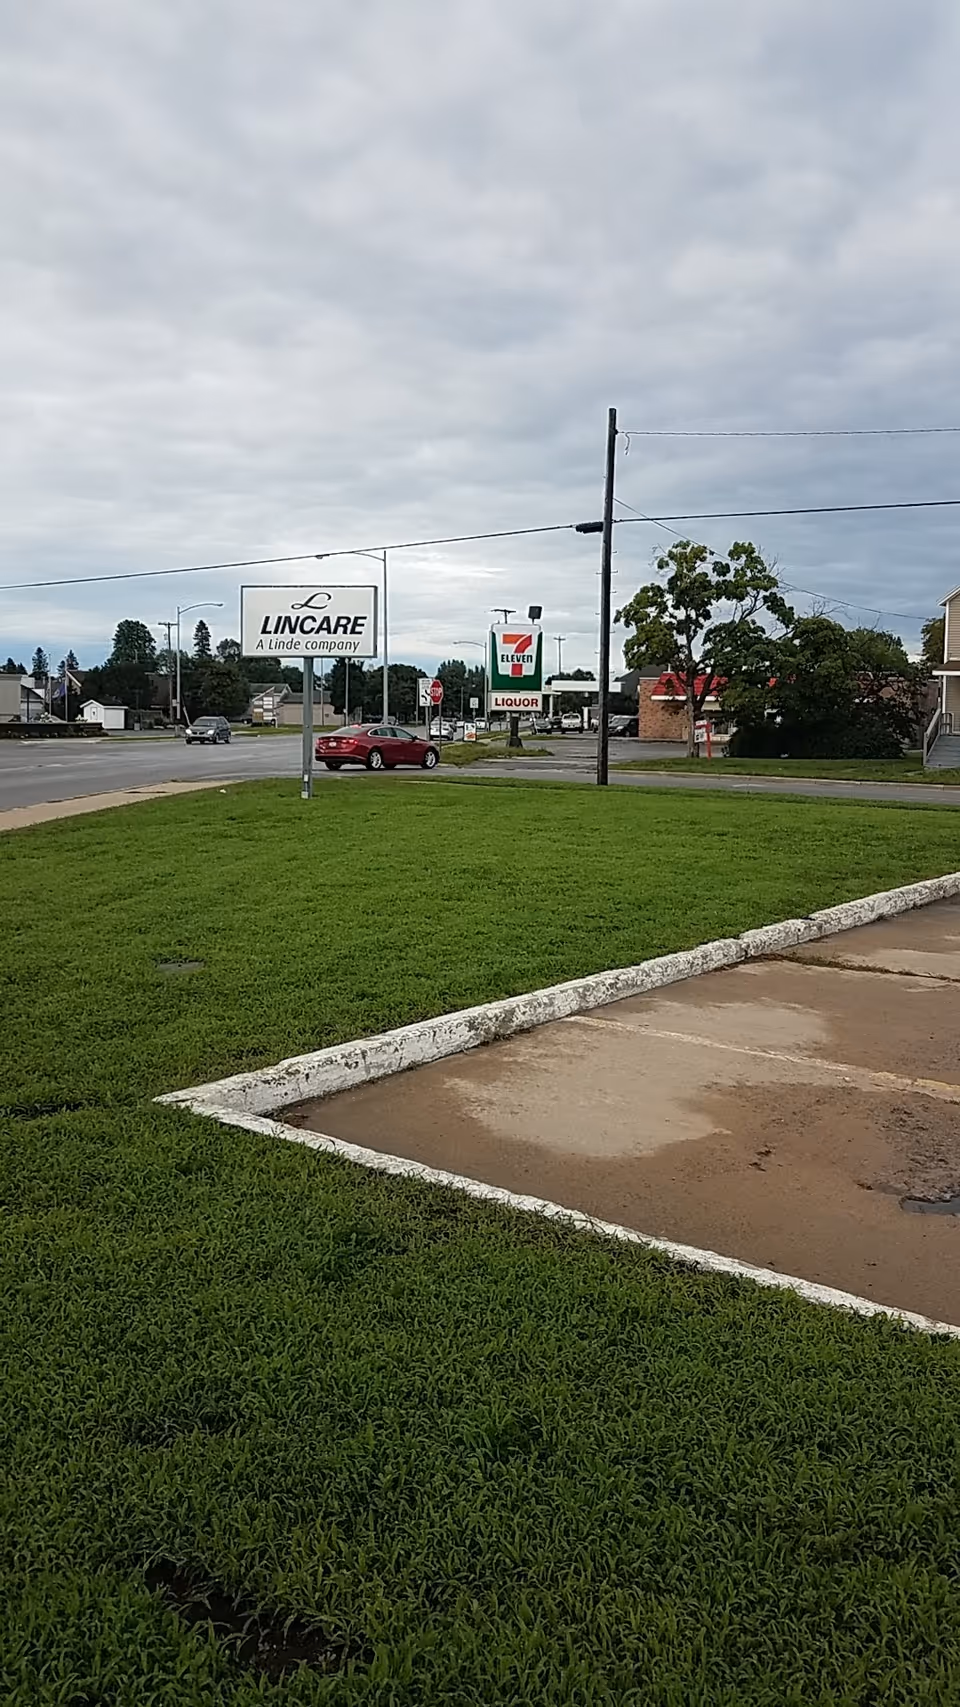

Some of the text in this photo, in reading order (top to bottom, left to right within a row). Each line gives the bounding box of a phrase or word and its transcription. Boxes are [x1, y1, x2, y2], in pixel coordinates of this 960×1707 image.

[260, 616, 367, 635] LINCARE
[256, 638, 360, 653] A Linde company
[502, 633, 533, 677] 7
[430, 687, 443, 697] STOP
[495, 697, 539, 708] LIQUOR
